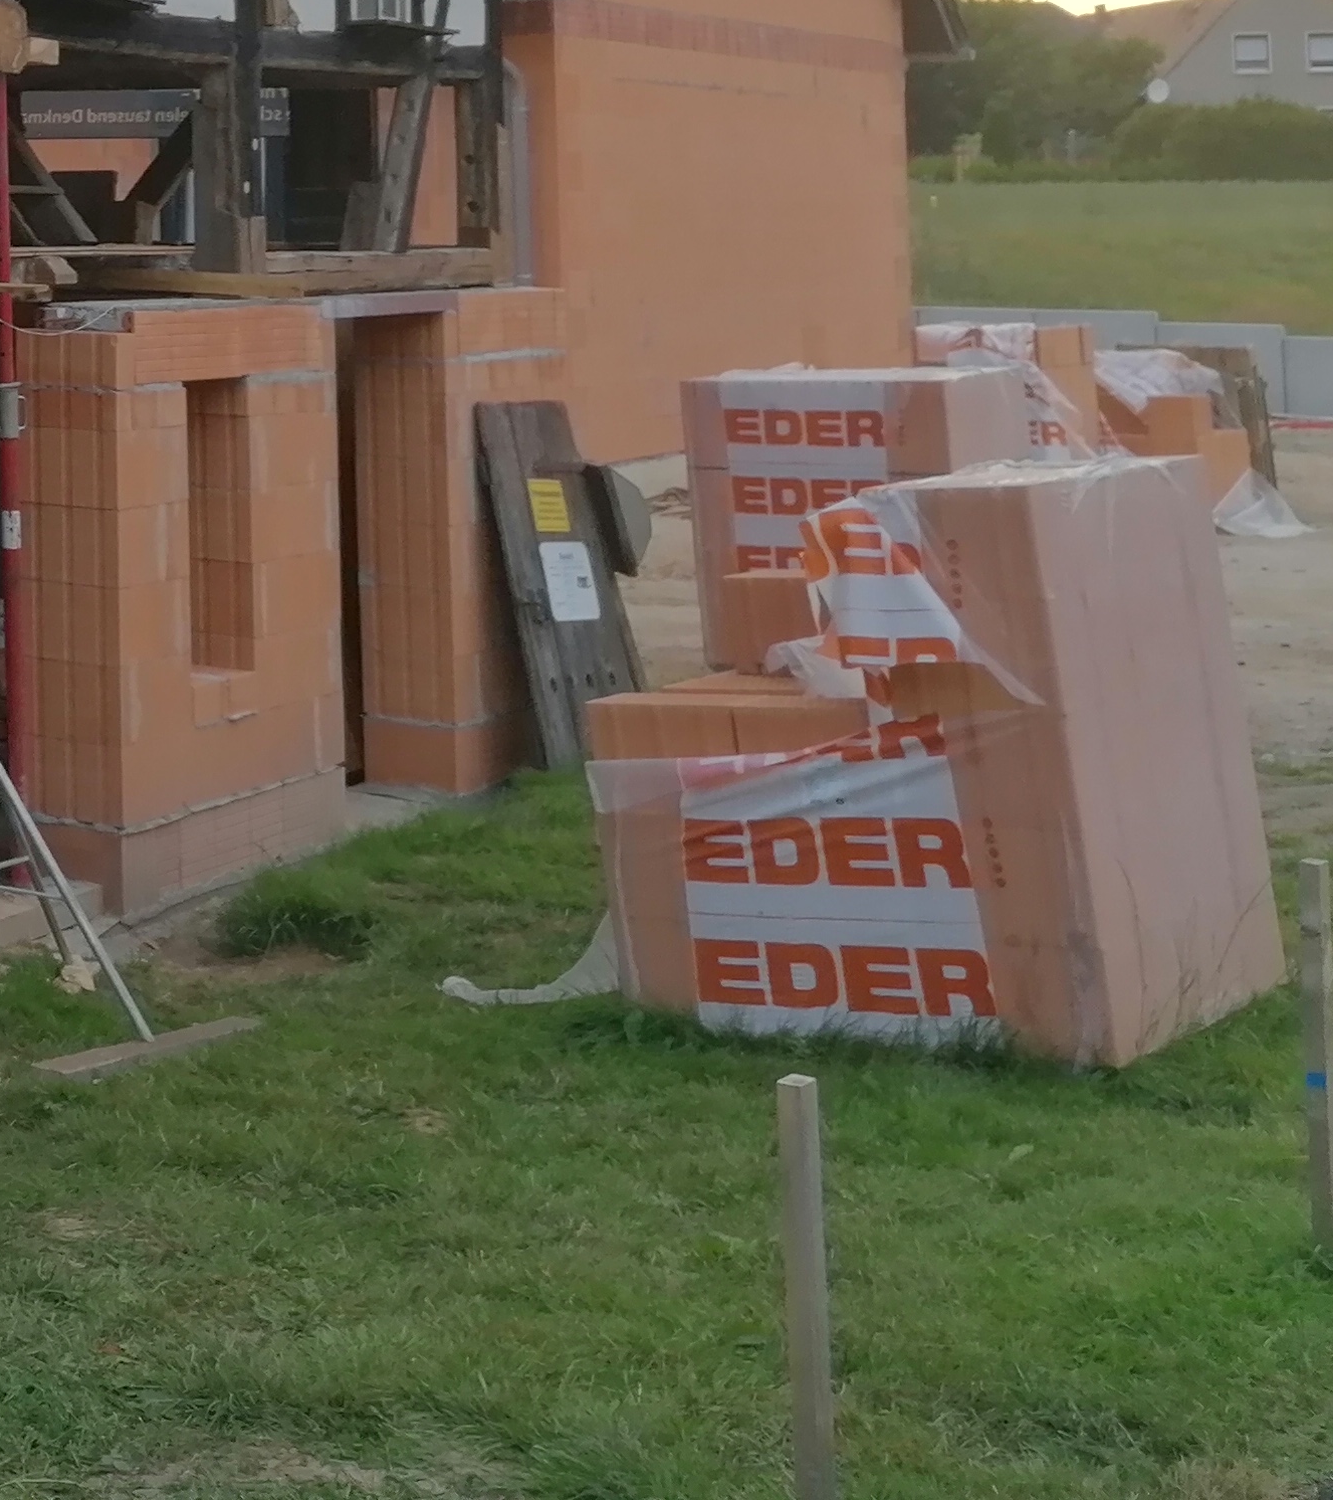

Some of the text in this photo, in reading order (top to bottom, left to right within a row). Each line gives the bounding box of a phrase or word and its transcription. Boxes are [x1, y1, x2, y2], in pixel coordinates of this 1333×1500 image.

[724, 409, 886, 447] EDER
[682, 817, 974, 889] EDER
[693, 939, 998, 1018] EDER
